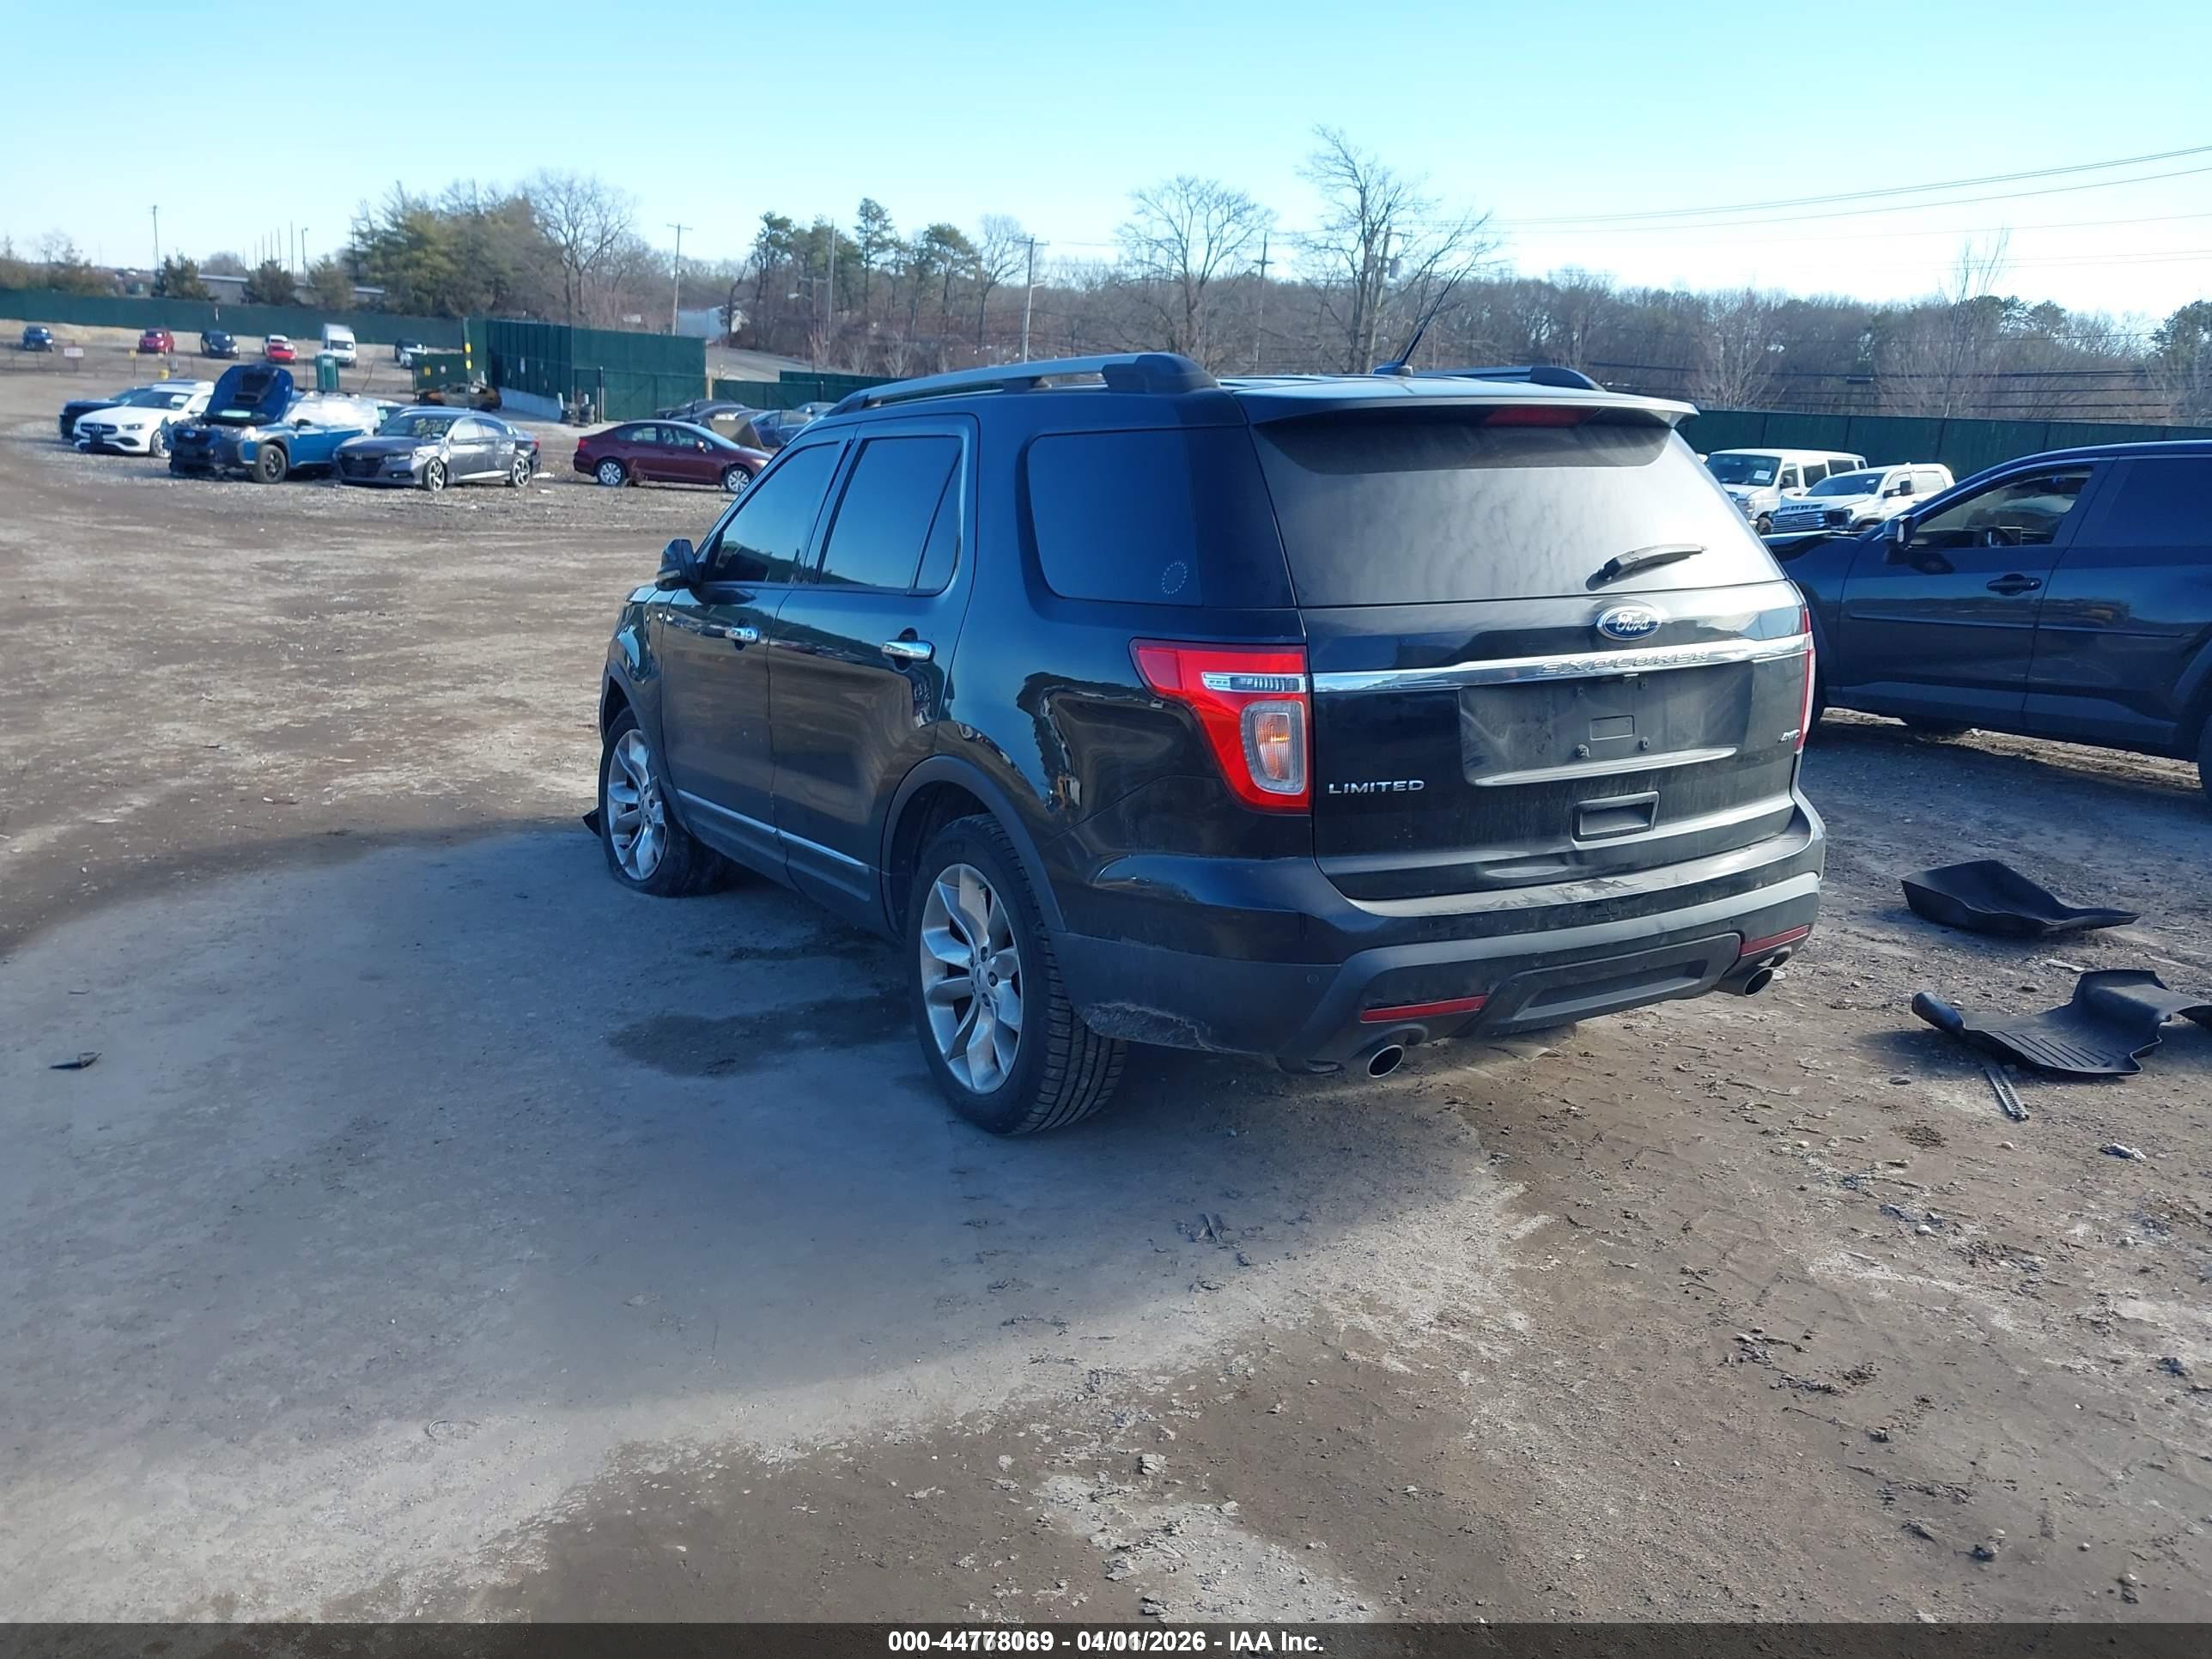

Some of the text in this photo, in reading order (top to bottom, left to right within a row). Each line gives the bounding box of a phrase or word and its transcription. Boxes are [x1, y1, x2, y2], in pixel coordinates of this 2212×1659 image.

[1615, 611, 1650, 632] Ford
[1540, 652, 1710, 675] EXPLORER
[1328, 780, 1425, 794] LIMITED
